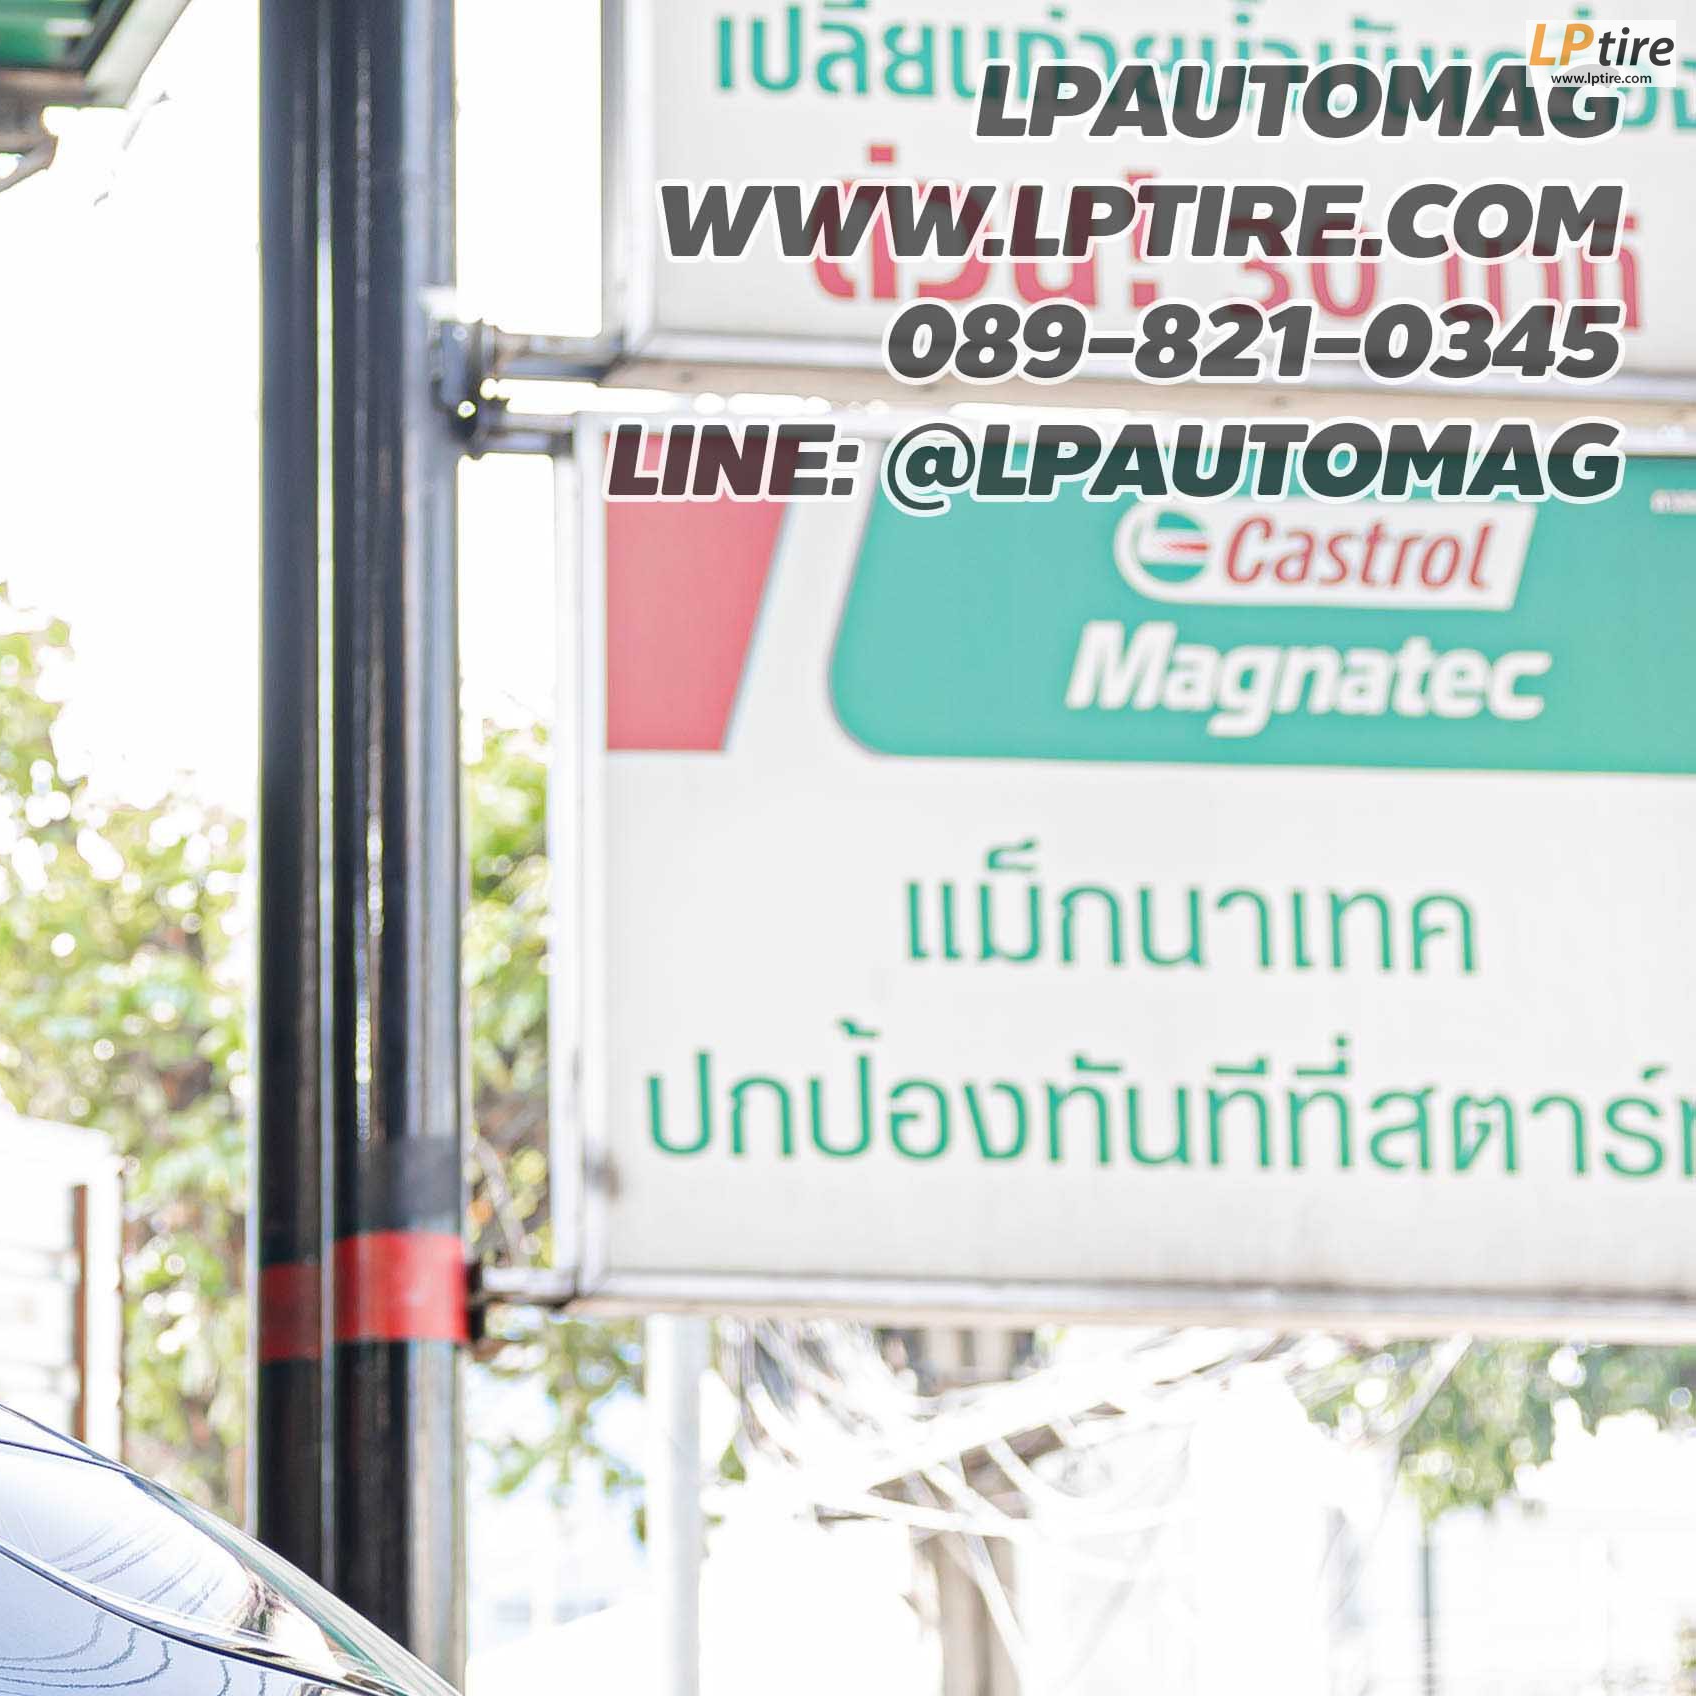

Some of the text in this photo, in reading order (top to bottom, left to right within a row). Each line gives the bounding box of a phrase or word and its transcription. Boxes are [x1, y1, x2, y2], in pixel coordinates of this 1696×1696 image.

[1224, 518, 1495, 591] Castrol
[1065, 620, 1553, 735] Magnatec
[905, 839, 1479, 973] แม็กนาเทค
